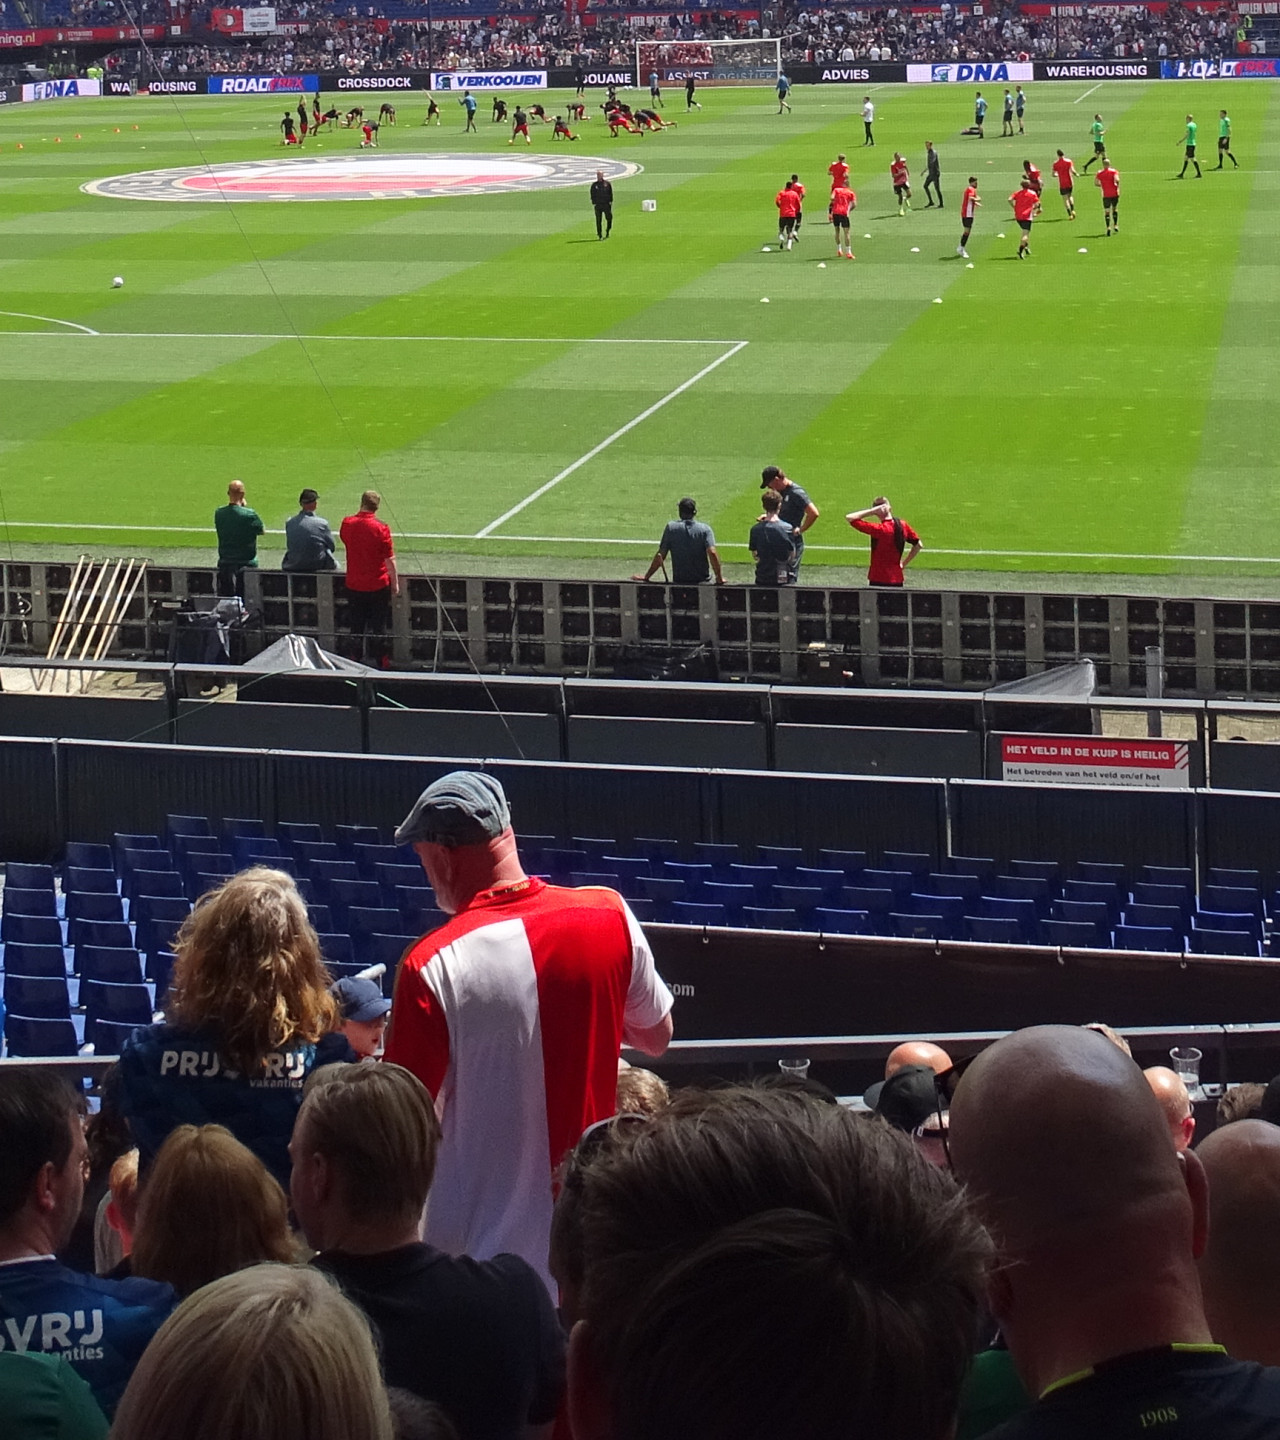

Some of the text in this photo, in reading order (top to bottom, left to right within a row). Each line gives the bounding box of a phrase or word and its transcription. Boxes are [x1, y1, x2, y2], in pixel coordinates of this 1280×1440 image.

[822, 69, 869, 80] ADVIES
[956, 64, 1009, 81] DNA
[1047, 65, 1147, 77] WAREHOUSING
[46, 80, 79, 97] DNA
[338, 77, 411, 89] CROSSDOCK
[1006, 745, 1170, 760] HET VELD IN DE KUIP IS HEILIG
[1024, 768, 1063, 777] betreden
[1082, 770, 1097, 778] het
[1099, 771, 1118, 779] veld
[1145, 773, 1161, 781] het
[249, 1078, 304, 1089] vakanties
[1140, 1406, 1178, 1428] 1908
